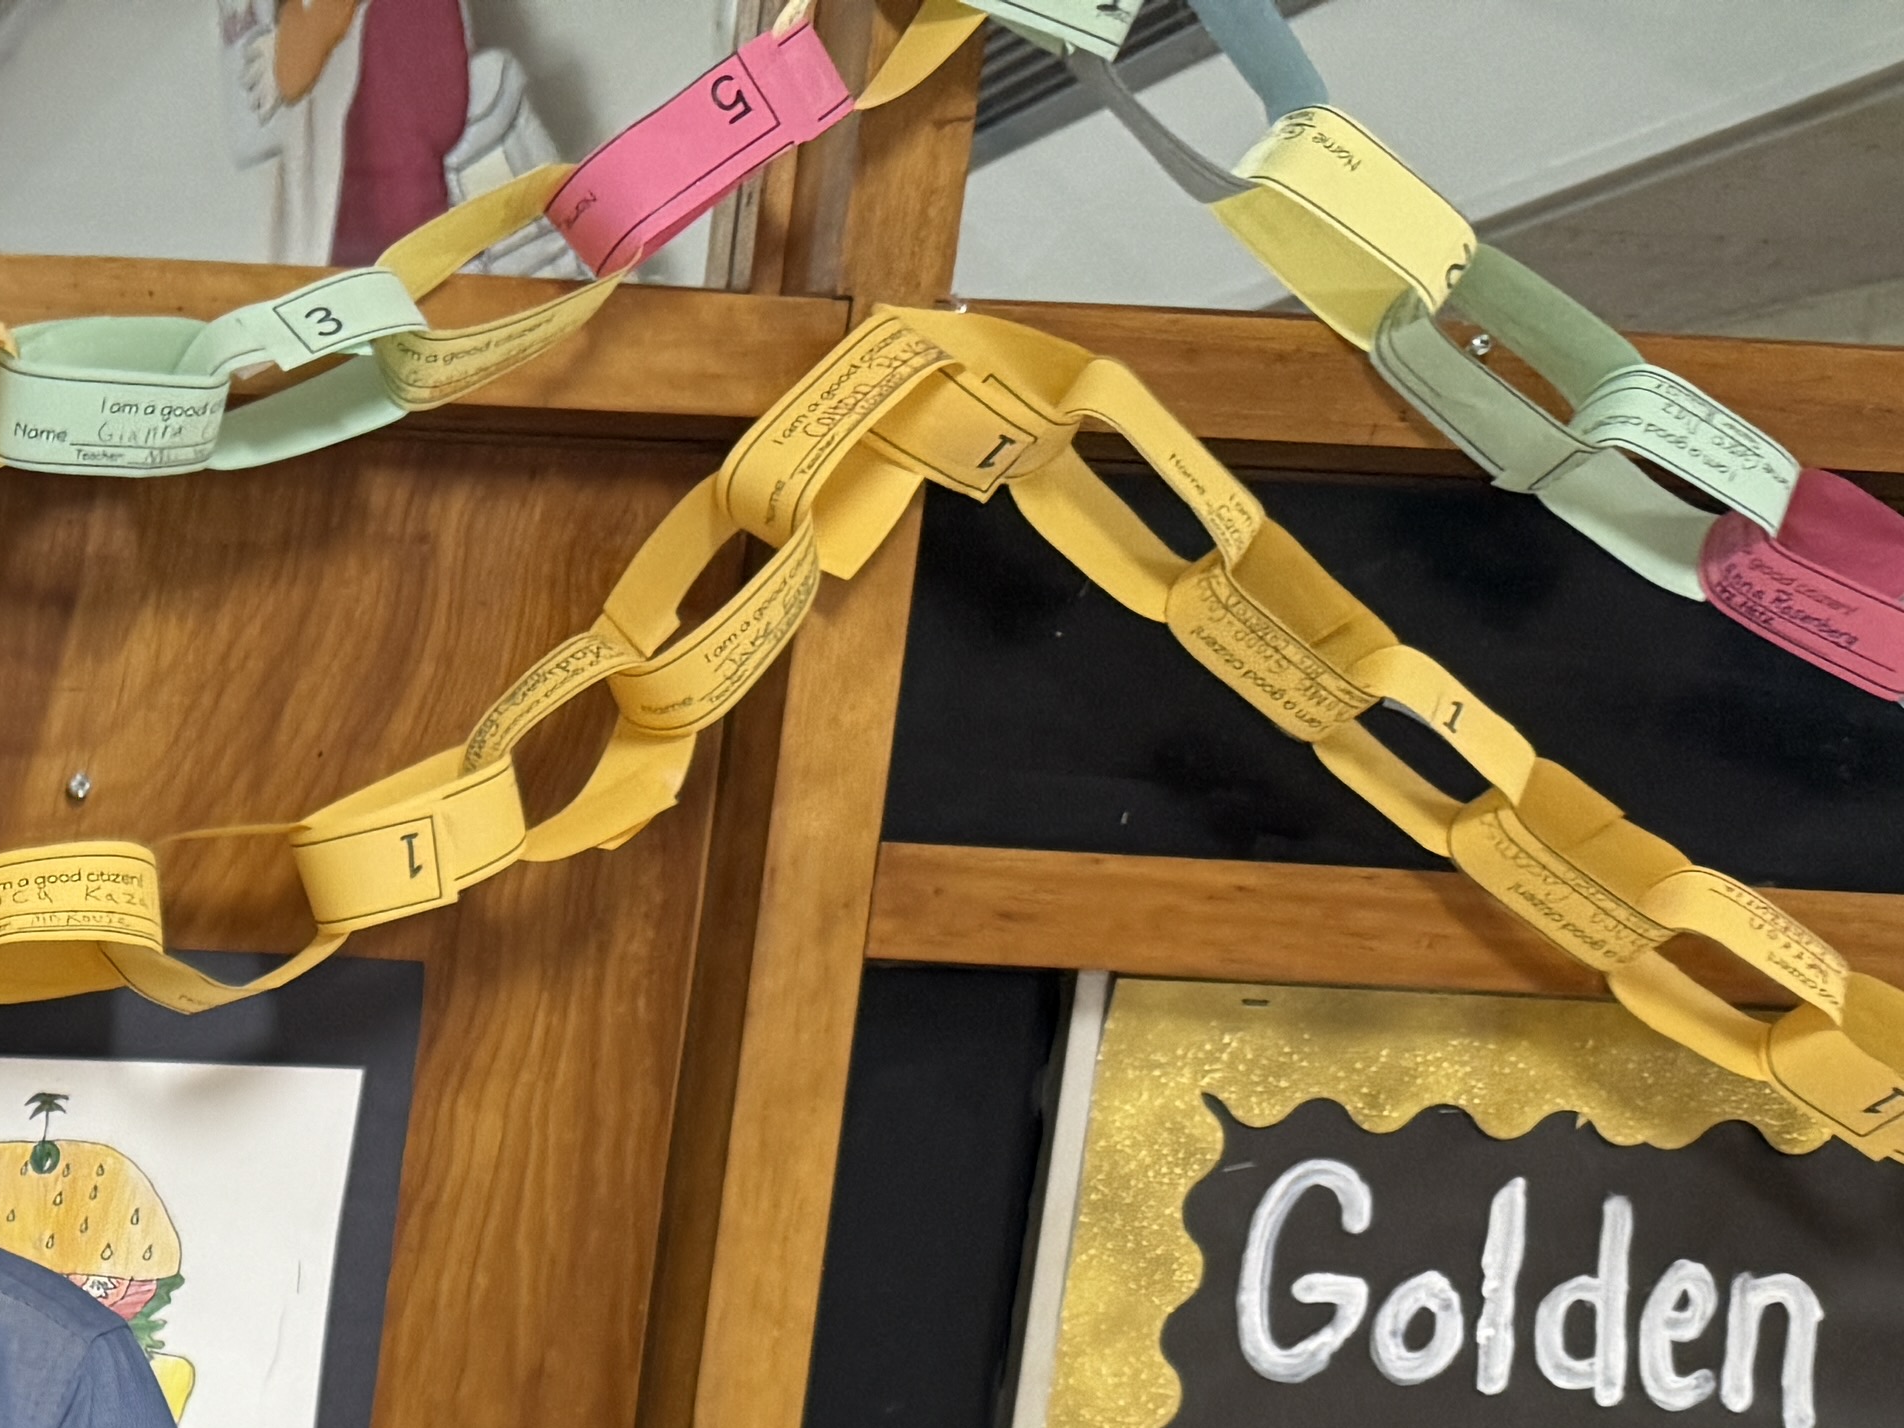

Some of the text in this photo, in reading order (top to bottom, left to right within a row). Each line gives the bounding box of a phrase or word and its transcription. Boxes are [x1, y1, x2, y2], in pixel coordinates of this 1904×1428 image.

[709, 75, 753, 125] 5
[304, 307, 344, 338] 3
[1441, 700, 1463, 734] 1
[402, 832, 423, 879] 1
[17, 878, 29, 887] a
[34, 869, 81, 890] good
